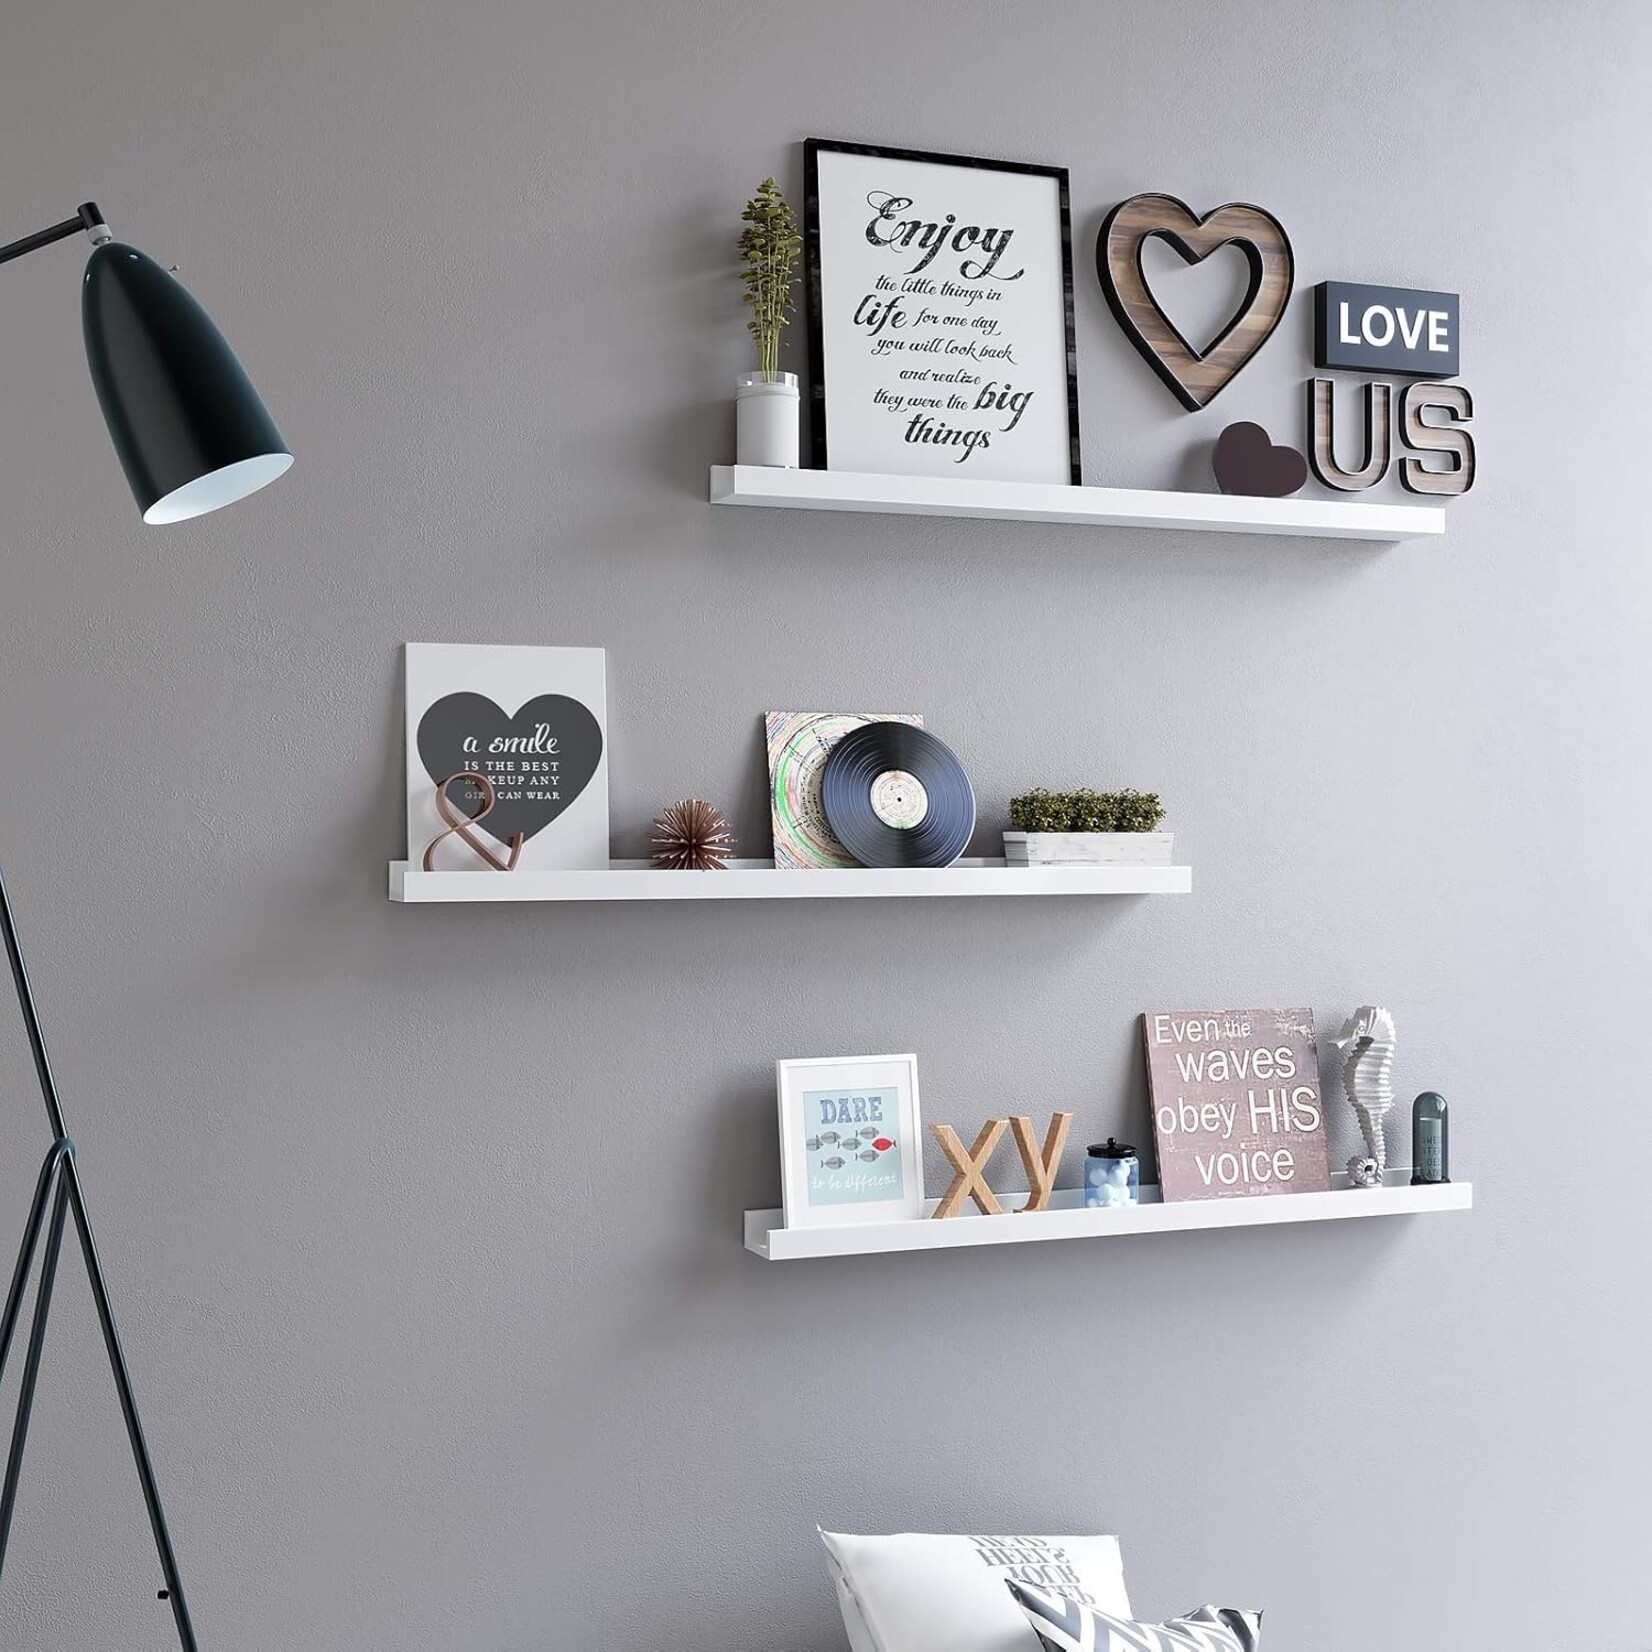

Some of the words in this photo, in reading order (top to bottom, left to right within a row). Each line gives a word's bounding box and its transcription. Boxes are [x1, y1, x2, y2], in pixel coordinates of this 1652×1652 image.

[865, 190, 1025, 281] Enjoy
[875, 274, 898, 291] the
[901, 277, 937, 295] little
[940, 280, 983, 307] things
[986, 288, 1003, 301] in
[853, 294, 908, 337] life
[912, 307, 940, 327] for
[942, 315, 968, 327] one
[971, 316, 1002, 336] day
[1339, 301, 1449, 353] LOVE
[871, 338, 905, 356] you
[908, 337, 944, 354] will
[944, 339, 982, 362] look
[978, 343, 1018, 365] back
[899, 369, 931, 382] and
[931, 368, 981, 385] realize
[873, 388, 908, 412] they
[907, 396, 944, 409] were
[946, 394, 968, 410] the
[972, 381, 1035, 432] big
[904, 413, 991, 463] things
[1307, 377, 1477, 496] US
[462, 736, 483, 753] a
[488, 722, 561, 754] smile
[464, 761, 479, 771] IS
[485, 761, 515, 771] THE
[521, 761, 560, 772] BEST
[464, 776, 524, 785] MKEUP
[530, 776, 560, 785] ANY
[497, 791, 522, 800] CAN
[526, 791, 561, 800] WEAR
[1154, 1015, 1220, 1044] Even
[1224, 1019, 1251, 1037] the
[1175, 1045, 1296, 1083] waves
[820, 1096, 883, 1125] DARE
[1157, 1096, 1236, 1139] obey
[1248, 1086, 1321, 1134] HIS
[1195, 1142, 1295, 1186] voice
